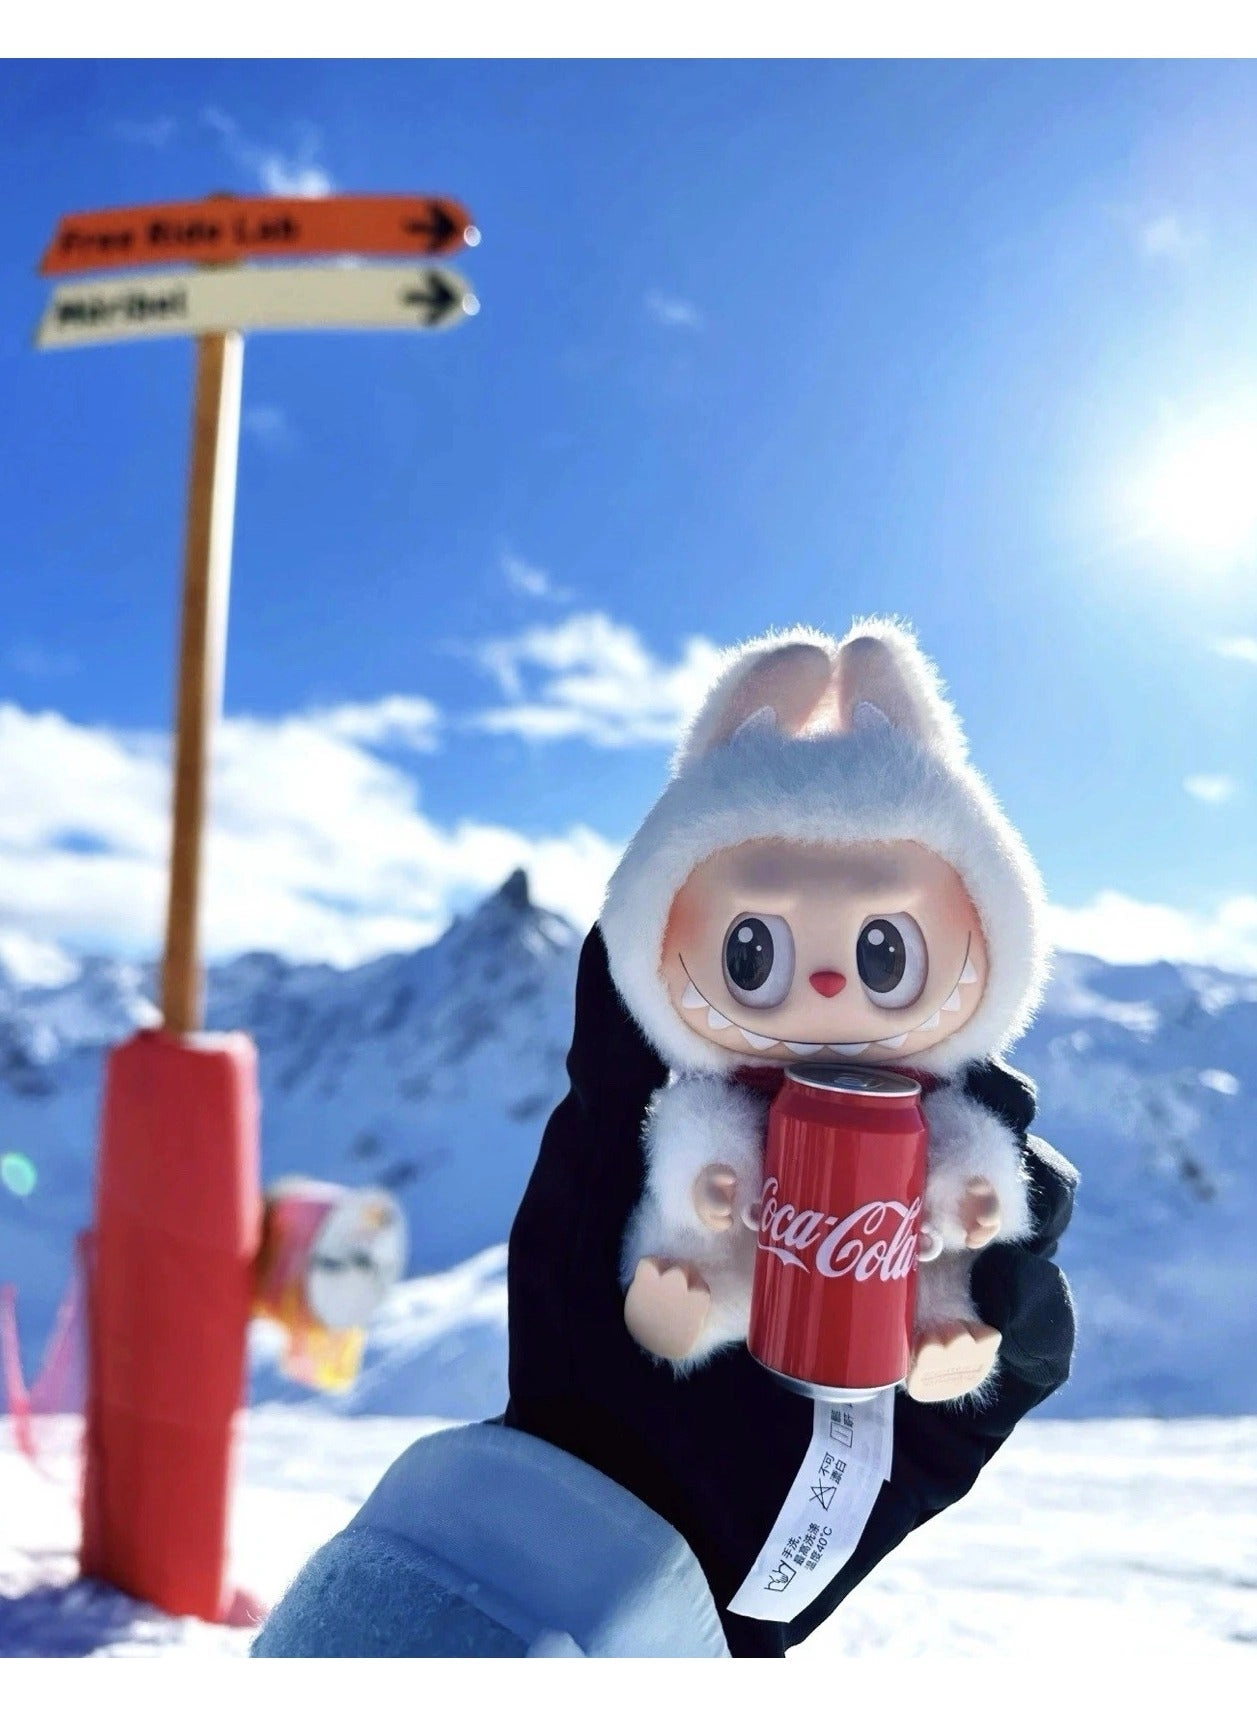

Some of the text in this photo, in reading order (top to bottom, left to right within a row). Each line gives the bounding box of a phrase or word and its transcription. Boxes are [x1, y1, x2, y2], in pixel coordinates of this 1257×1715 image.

[149, 219, 221, 245] Ride
[233, 215, 297, 245] Lab
[818, 1451, 835, 1477] 不可
[829, 1460, 847, 1485] 漂白
